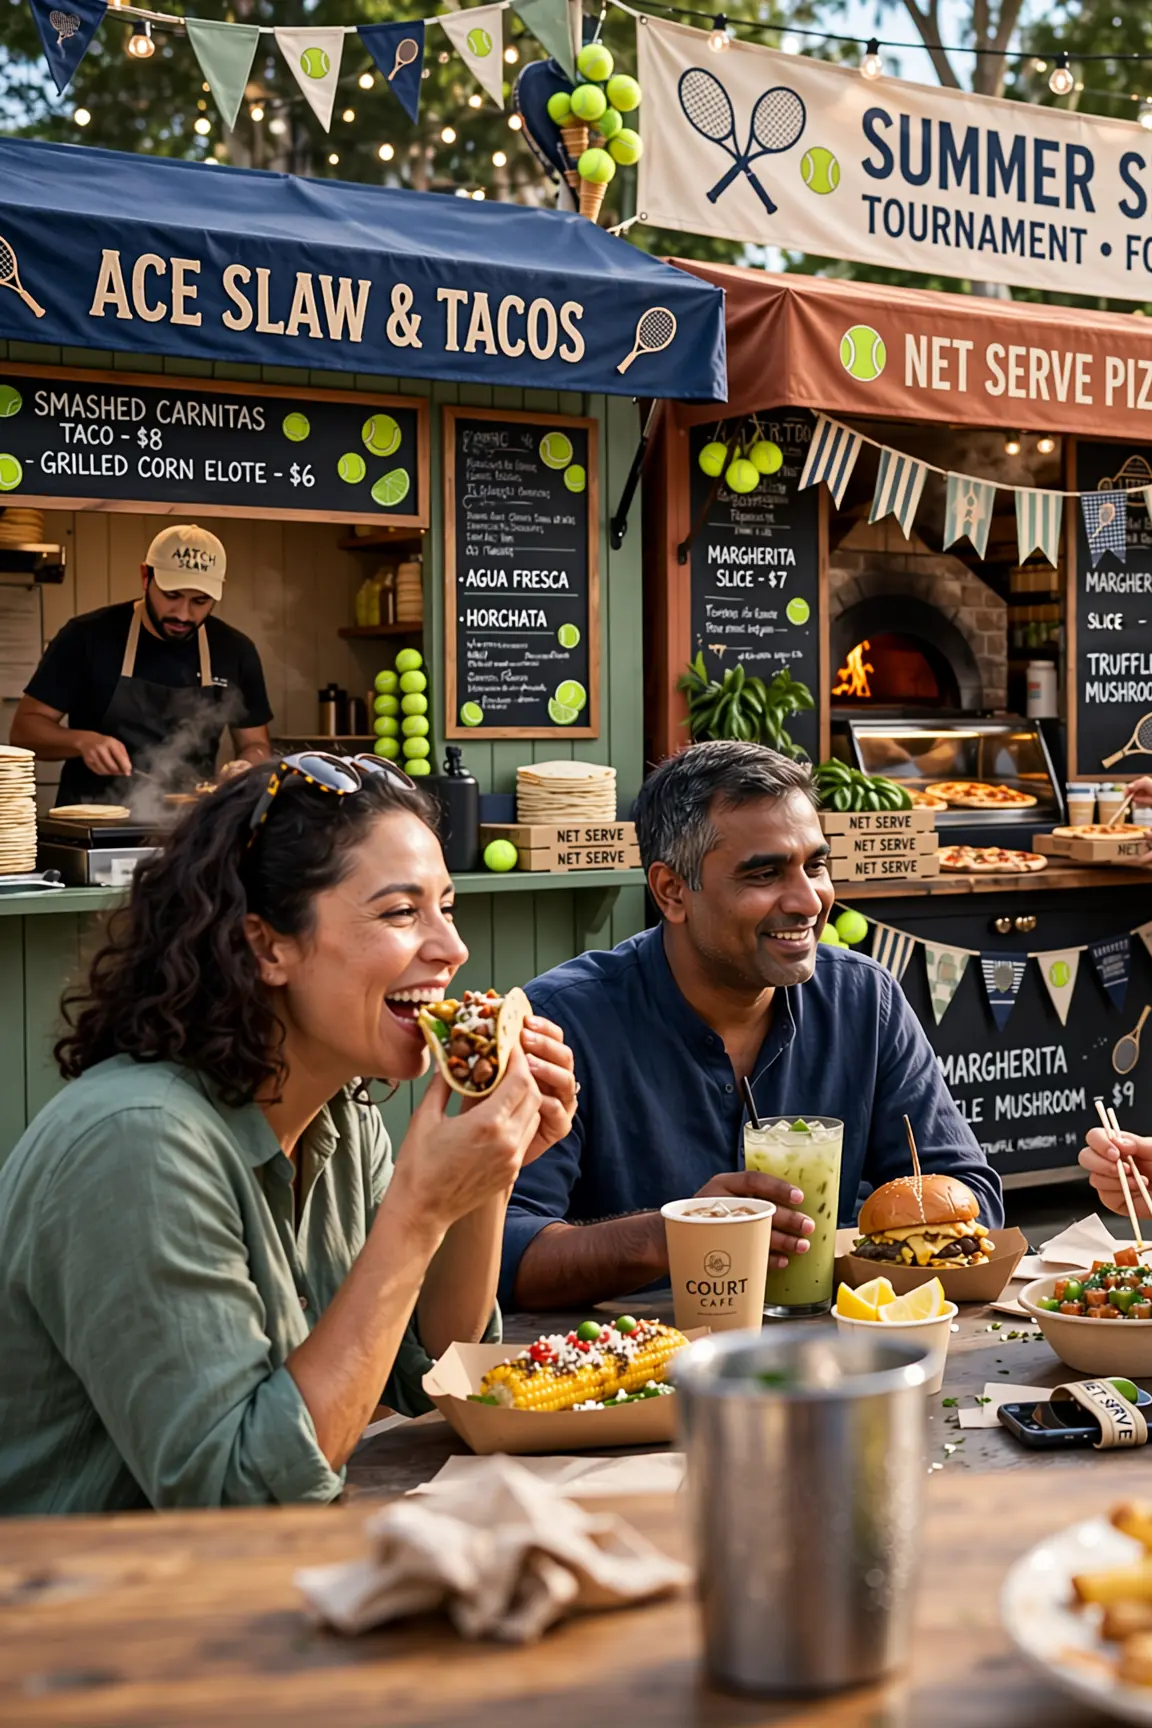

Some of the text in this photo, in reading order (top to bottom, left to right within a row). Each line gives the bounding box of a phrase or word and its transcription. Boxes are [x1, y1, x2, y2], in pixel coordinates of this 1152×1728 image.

[861, 106, 1096, 213] SUMMER
[861, 194, 1087, 266] TOURNAMENT
[90, 249, 585, 363] ACE SLAW & TACOS
[904, 333, 973, 393] NET
[985, 342, 1094, 405] SERVE
[34, 391, 266, 431] SMASHED CARNITAS
[60, 423, 113, 445] TACO
[137, 426, 163, 450] $8
[41, 453, 128, 478] GRILLED
[138, 455, 194, 480] CORN
[204, 459, 266, 483] ELOTE
[290, 463, 316, 487] $6
[708, 545, 796, 566] MARGHERITA
[466, 569, 569, 588] AGUA FRESCA
[716, 570, 754, 587] SLICE
[769, 571, 787, 589] $7
[467, 609, 547, 627] HORCHATA
[1087, 613, 1123, 630] SLICE
[849, 815, 912, 829] NET SERVE
[557, 828, 624, 842] NET SERVE
[854, 837, 916, 852] NET SERVE
[558, 850, 624, 865] NET SERVE
[1118, 843, 1140, 855] NET
[855, 859, 917, 875] NET SERVE
[936, 1045, 1068, 1085] MARGHERITA
[995, 1087, 1086, 1121] MUSHROOM
[1112, 1080, 1134, 1108] $9
[686, 1278, 748, 1295] COURT
[701, 1297, 734, 1307] CAFE
